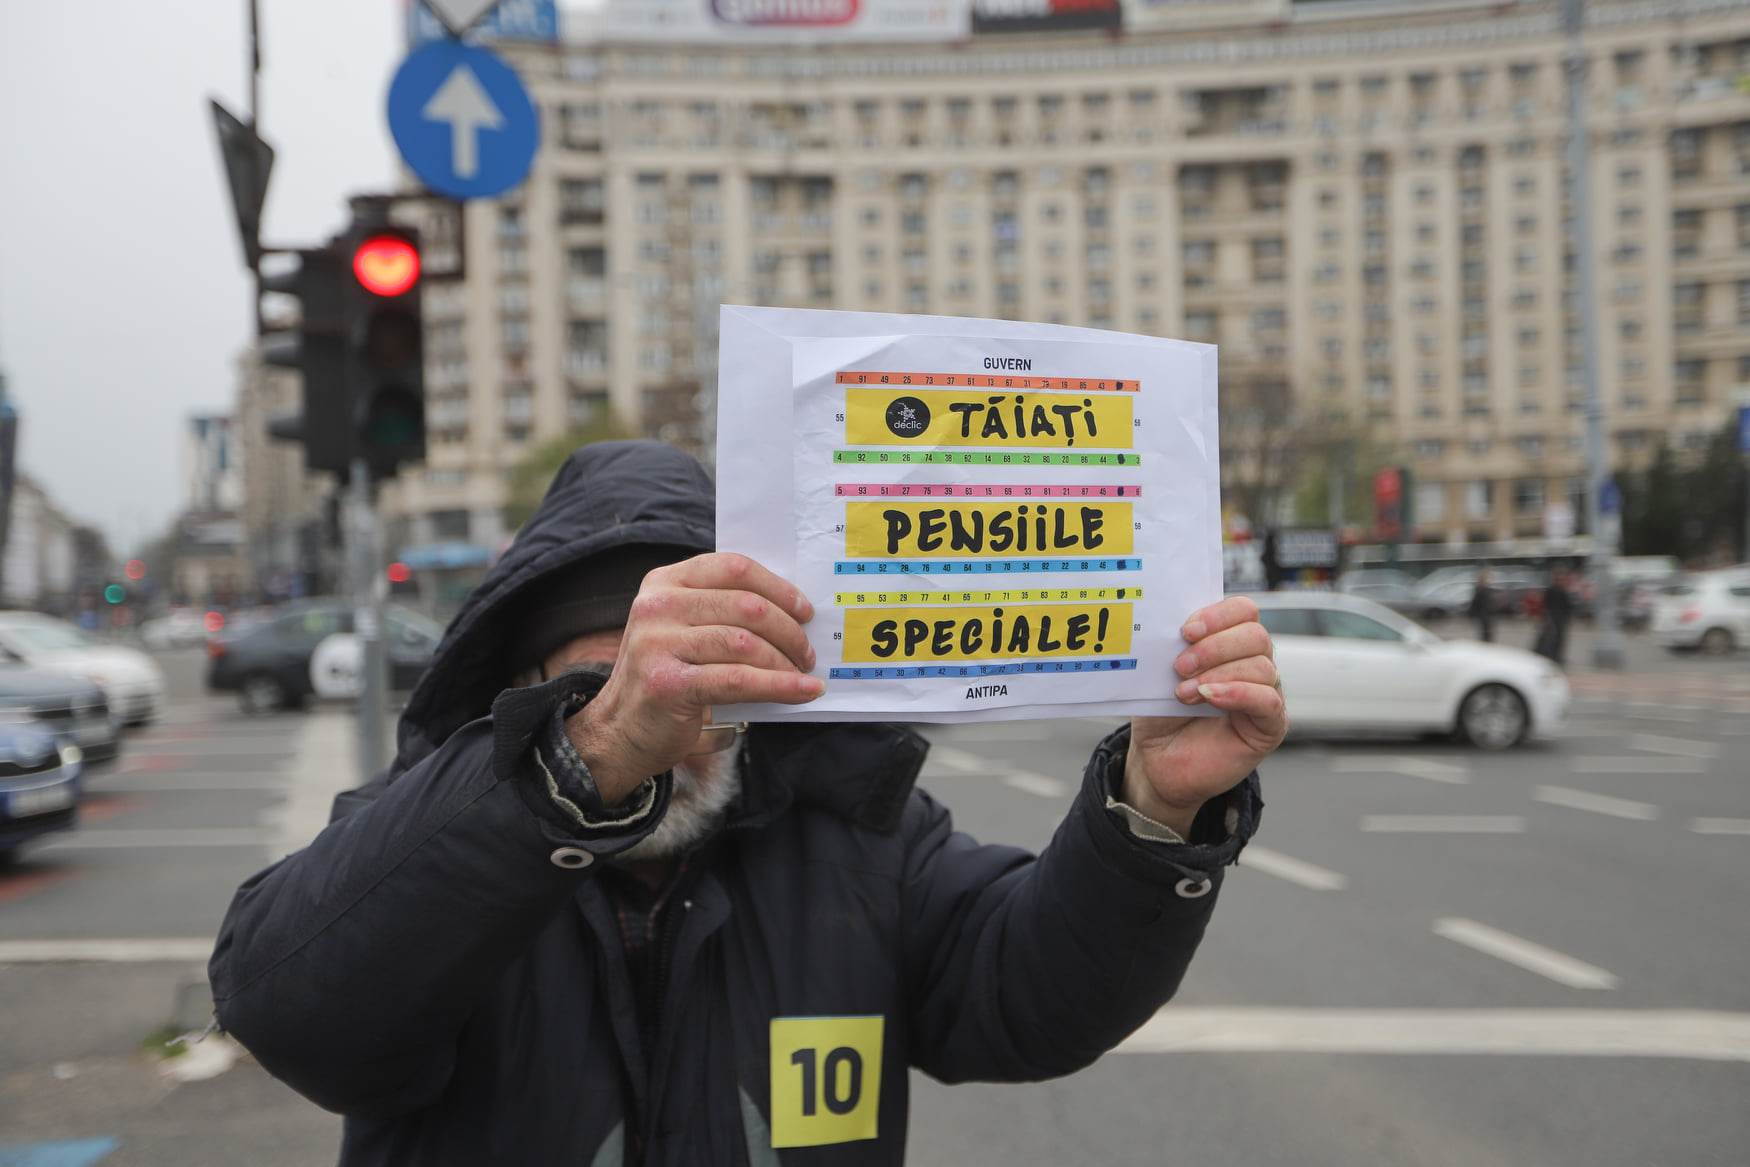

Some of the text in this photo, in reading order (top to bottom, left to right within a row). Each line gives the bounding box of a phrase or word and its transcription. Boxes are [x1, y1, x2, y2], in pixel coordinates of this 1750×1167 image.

[983, 357, 1032, 371] GUVERN
[835, 413, 844, 422] 55
[836, 524, 844, 532] 57
[1133, 623, 1141, 631] 60
[833, 632, 842, 640] 59
[966, 684, 1008, 700] ANTIPA
[791, 1046, 863, 1117] 10
